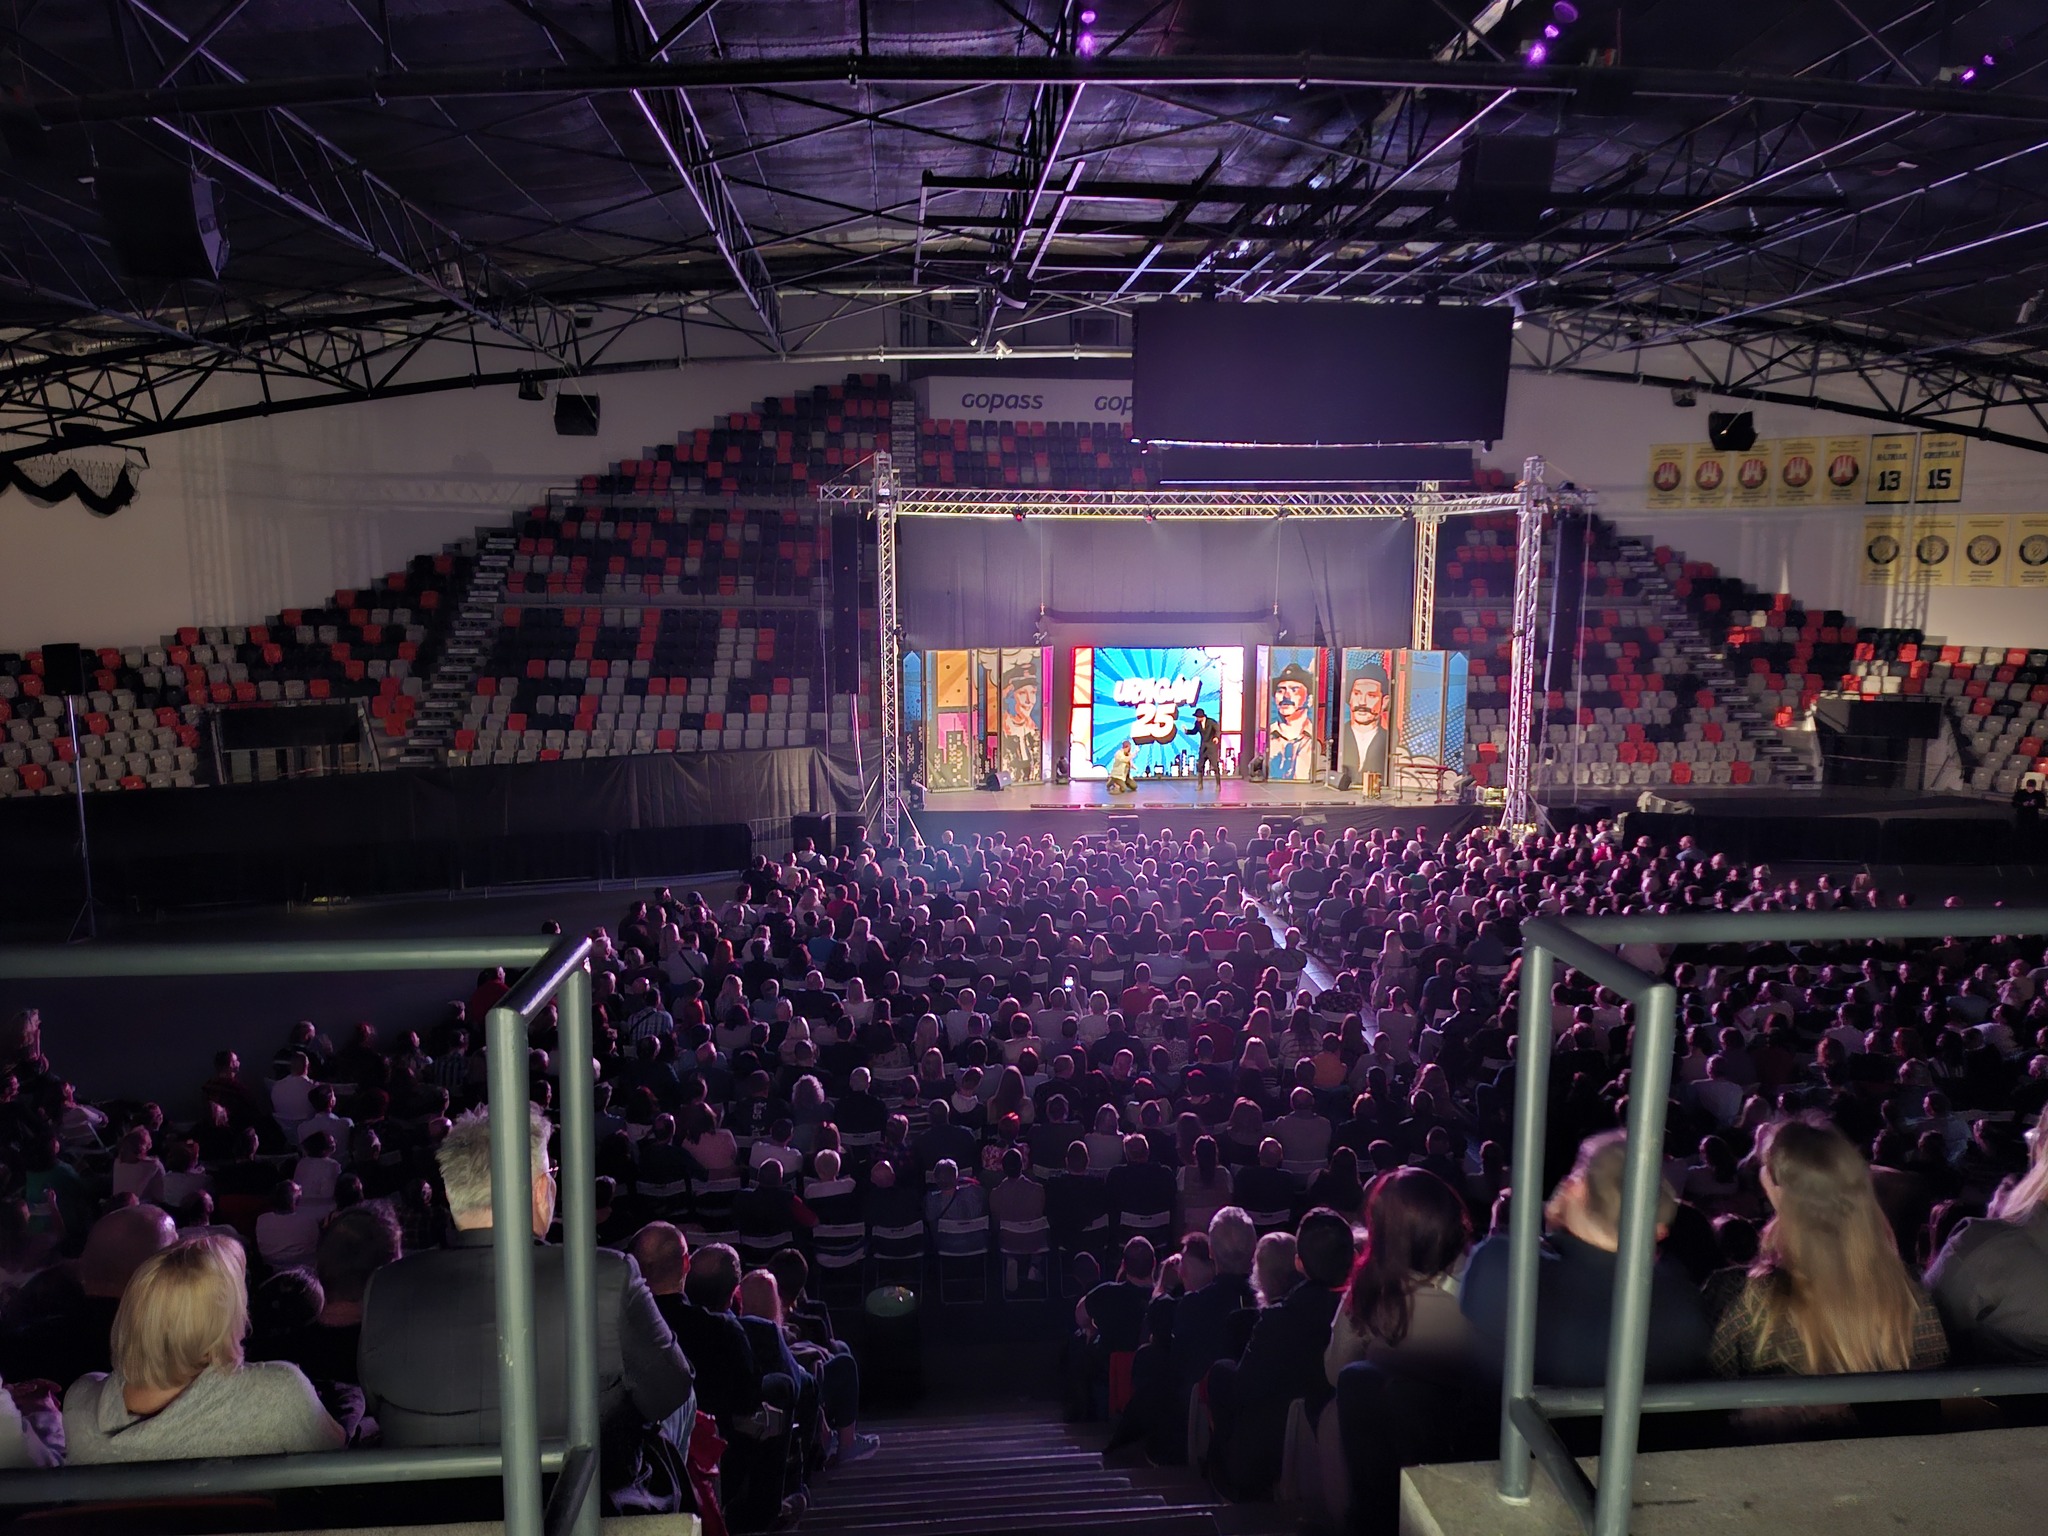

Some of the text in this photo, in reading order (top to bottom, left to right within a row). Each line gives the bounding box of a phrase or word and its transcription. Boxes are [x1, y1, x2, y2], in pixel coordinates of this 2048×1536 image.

[1878, 470, 1902, 491] 13
[1927, 468, 1952, 490] 15
[1130, 703, 1179, 745] 25
